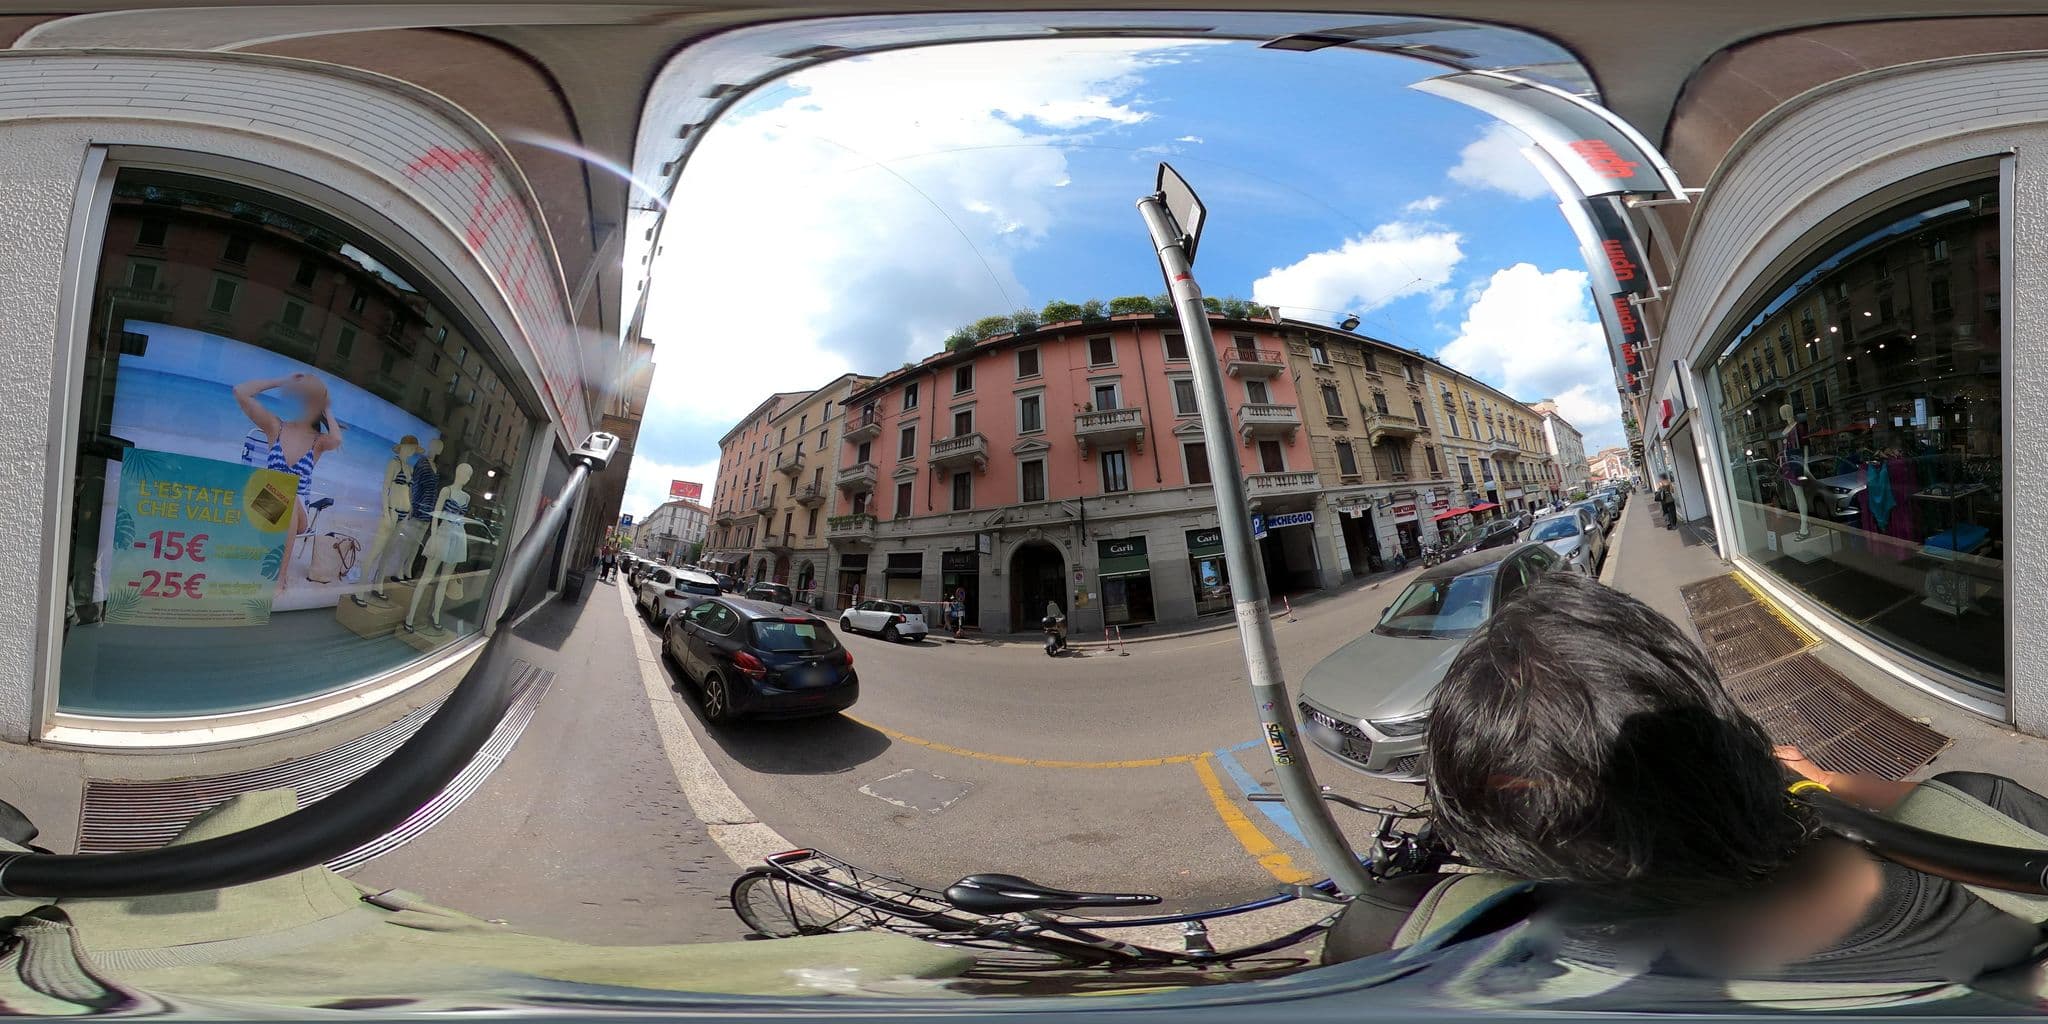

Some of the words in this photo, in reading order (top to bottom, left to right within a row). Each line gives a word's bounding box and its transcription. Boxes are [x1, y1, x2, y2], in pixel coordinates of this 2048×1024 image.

[1568, 138, 1643, 178] upim
[1601, 239, 1636, 280] upim
[1613, 297, 1637, 334] upim
[138, 479, 235, 506] L'ESTATE
[136, 501, 180, 519] CHE
[186, 505, 241, 524] VALE!
[1253, 518, 1260, 533] P
[1268, 512, 1313, 527] ARCHEGGIO
[133, 530, 209, 563] -15€
[1110, 544, 1134, 553] Carli
[1196, 533, 1219, 543] Carli
[127, 570, 208, 599] -25€
